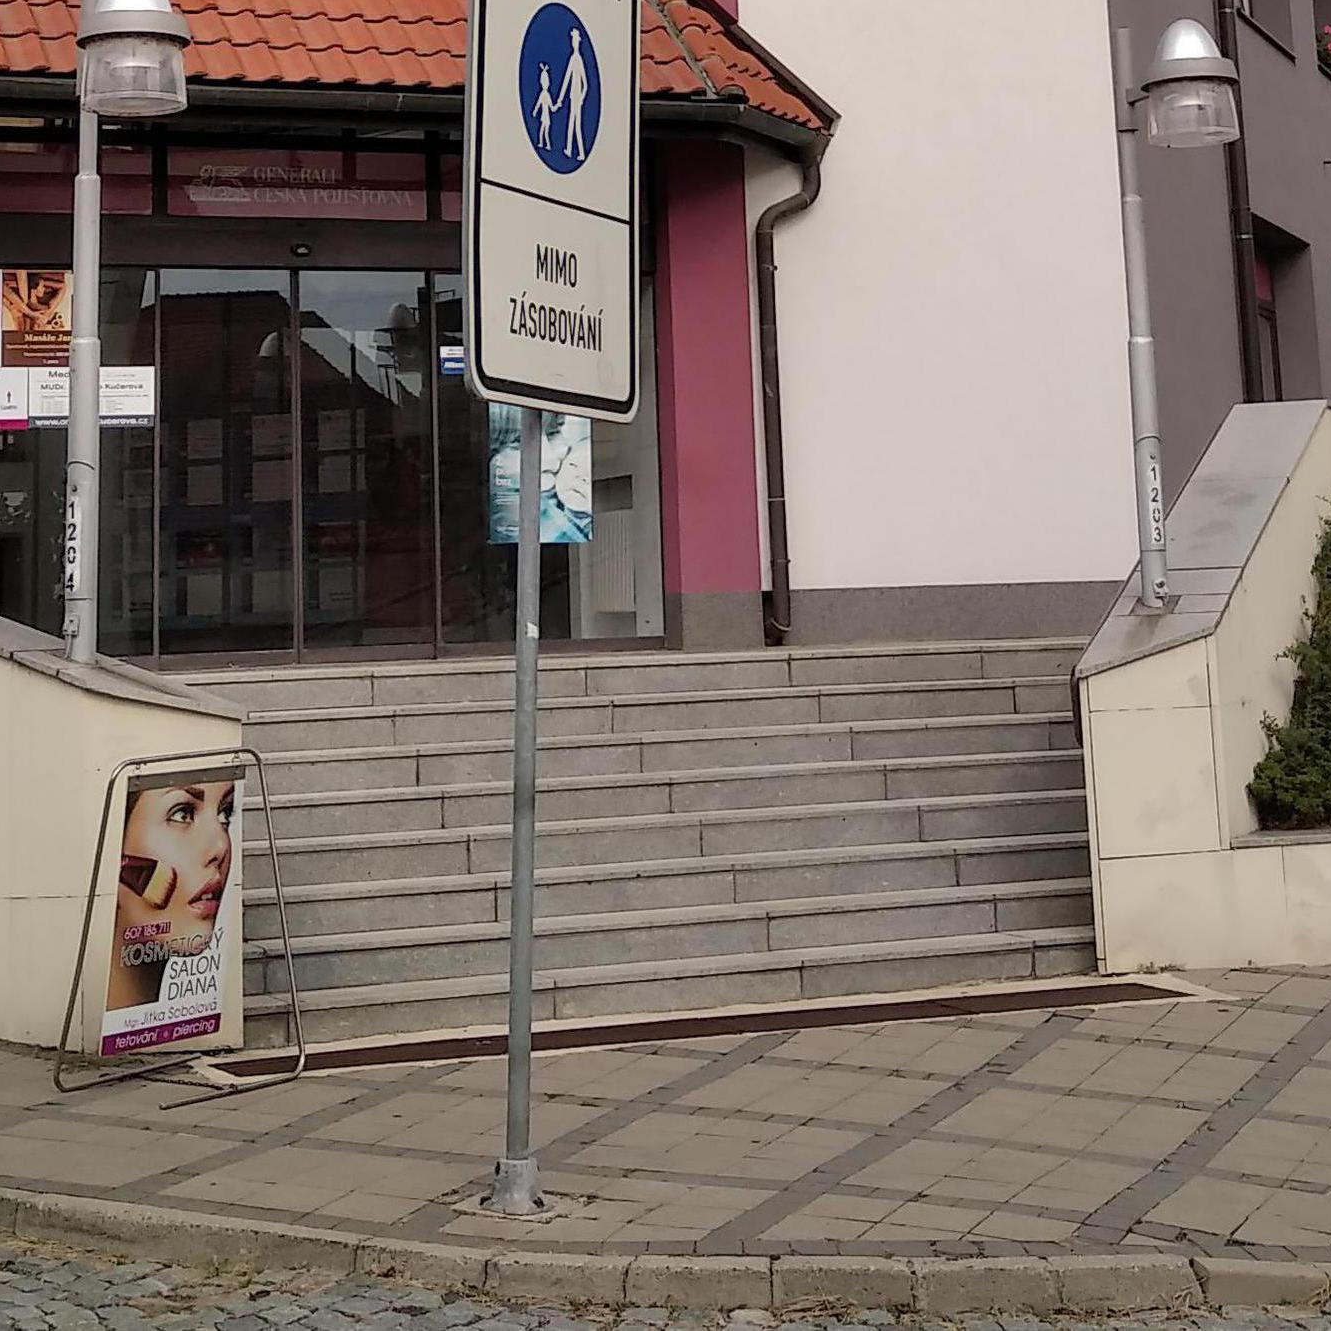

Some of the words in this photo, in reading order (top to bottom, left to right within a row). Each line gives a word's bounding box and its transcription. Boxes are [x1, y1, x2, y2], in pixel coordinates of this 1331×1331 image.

[253, 165, 338, 184] GENERALI
[536, 243, 578, 288] MIMO
[509, 290, 604, 352] ZÁSOBOVÁNÍ
[119, 926, 224, 968] KOSMETICKÝ
[123, 927, 143, 940] 607
[169, 953, 222, 980] SALON
[166, 974, 218, 1001] DIANA
[114, 1028, 159, 1049] tetování
[172, 1018, 216, 1040] piercing
